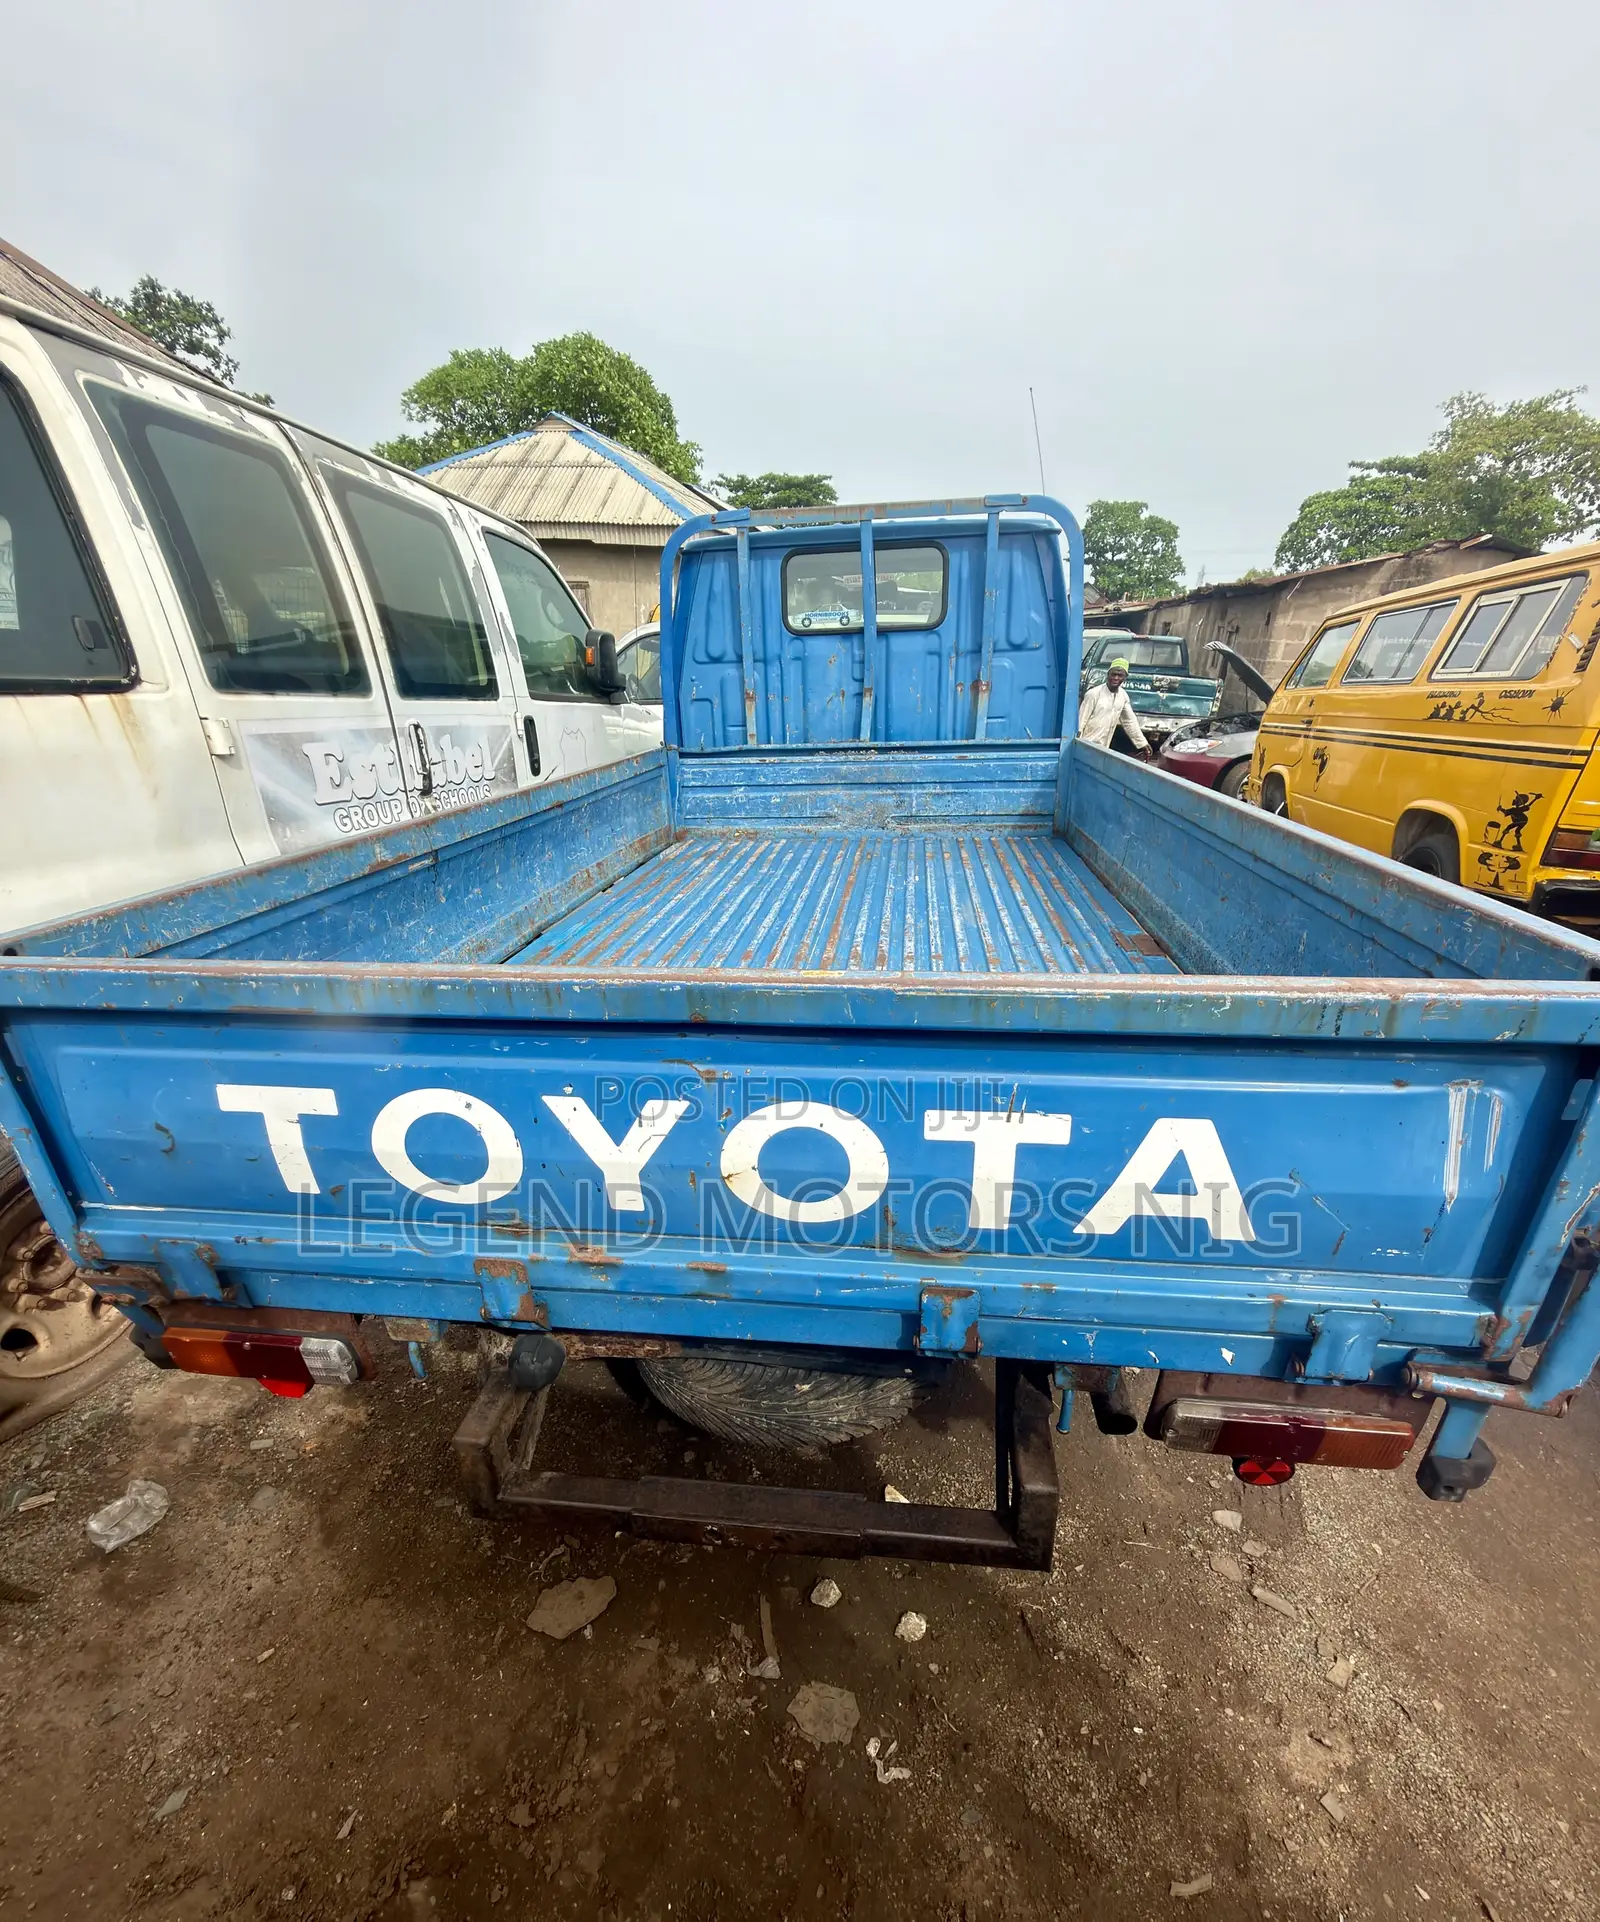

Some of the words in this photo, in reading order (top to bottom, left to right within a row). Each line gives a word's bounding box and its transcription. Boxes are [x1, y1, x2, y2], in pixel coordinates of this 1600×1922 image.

[1499, 689, 1536, 699] OSHODI
[333, 798, 402, 833] GROUP
[433, 784, 492, 811] SCHOOLS
[216, 1083, 1256, 1242] TOYOTA
